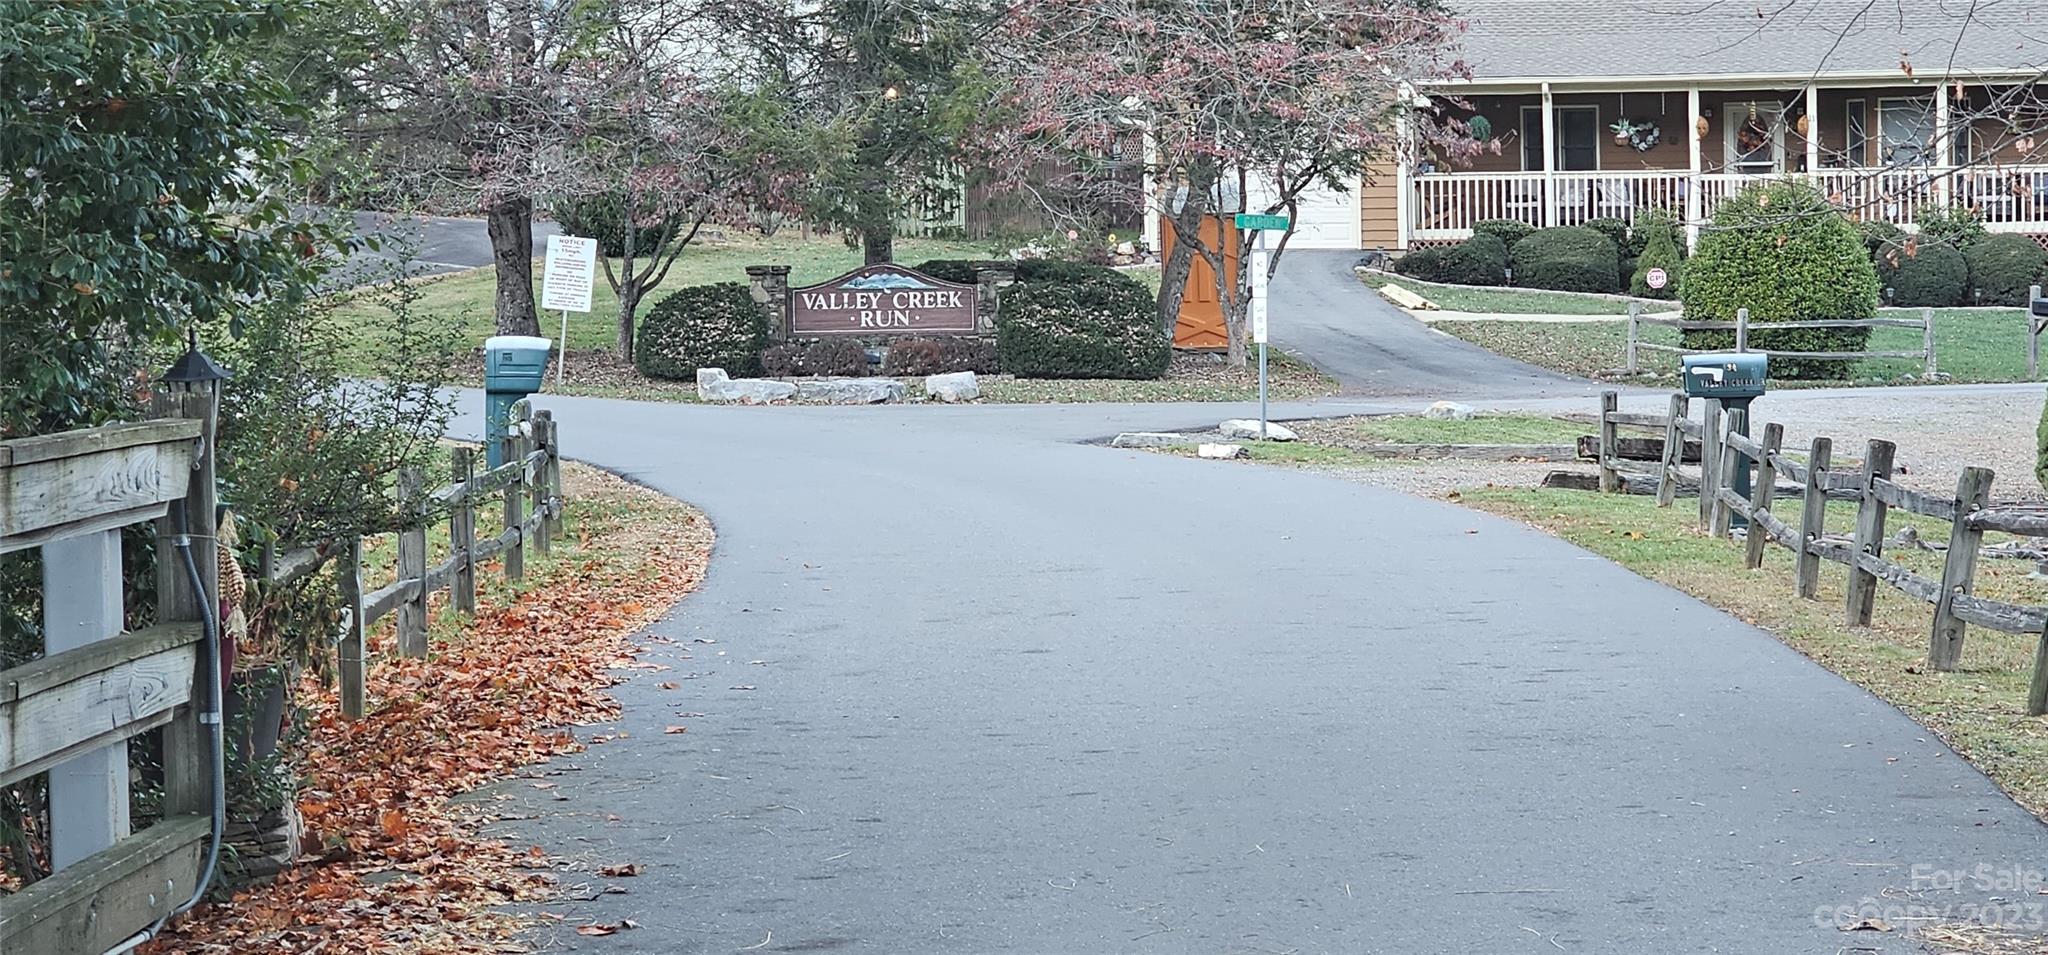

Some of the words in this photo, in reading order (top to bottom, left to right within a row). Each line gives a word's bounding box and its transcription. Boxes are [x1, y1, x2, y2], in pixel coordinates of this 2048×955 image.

[801, 292, 882, 310] VALLEY
[892, 291, 963, 310] CREEK
[860, 310, 910, 327] RUN
